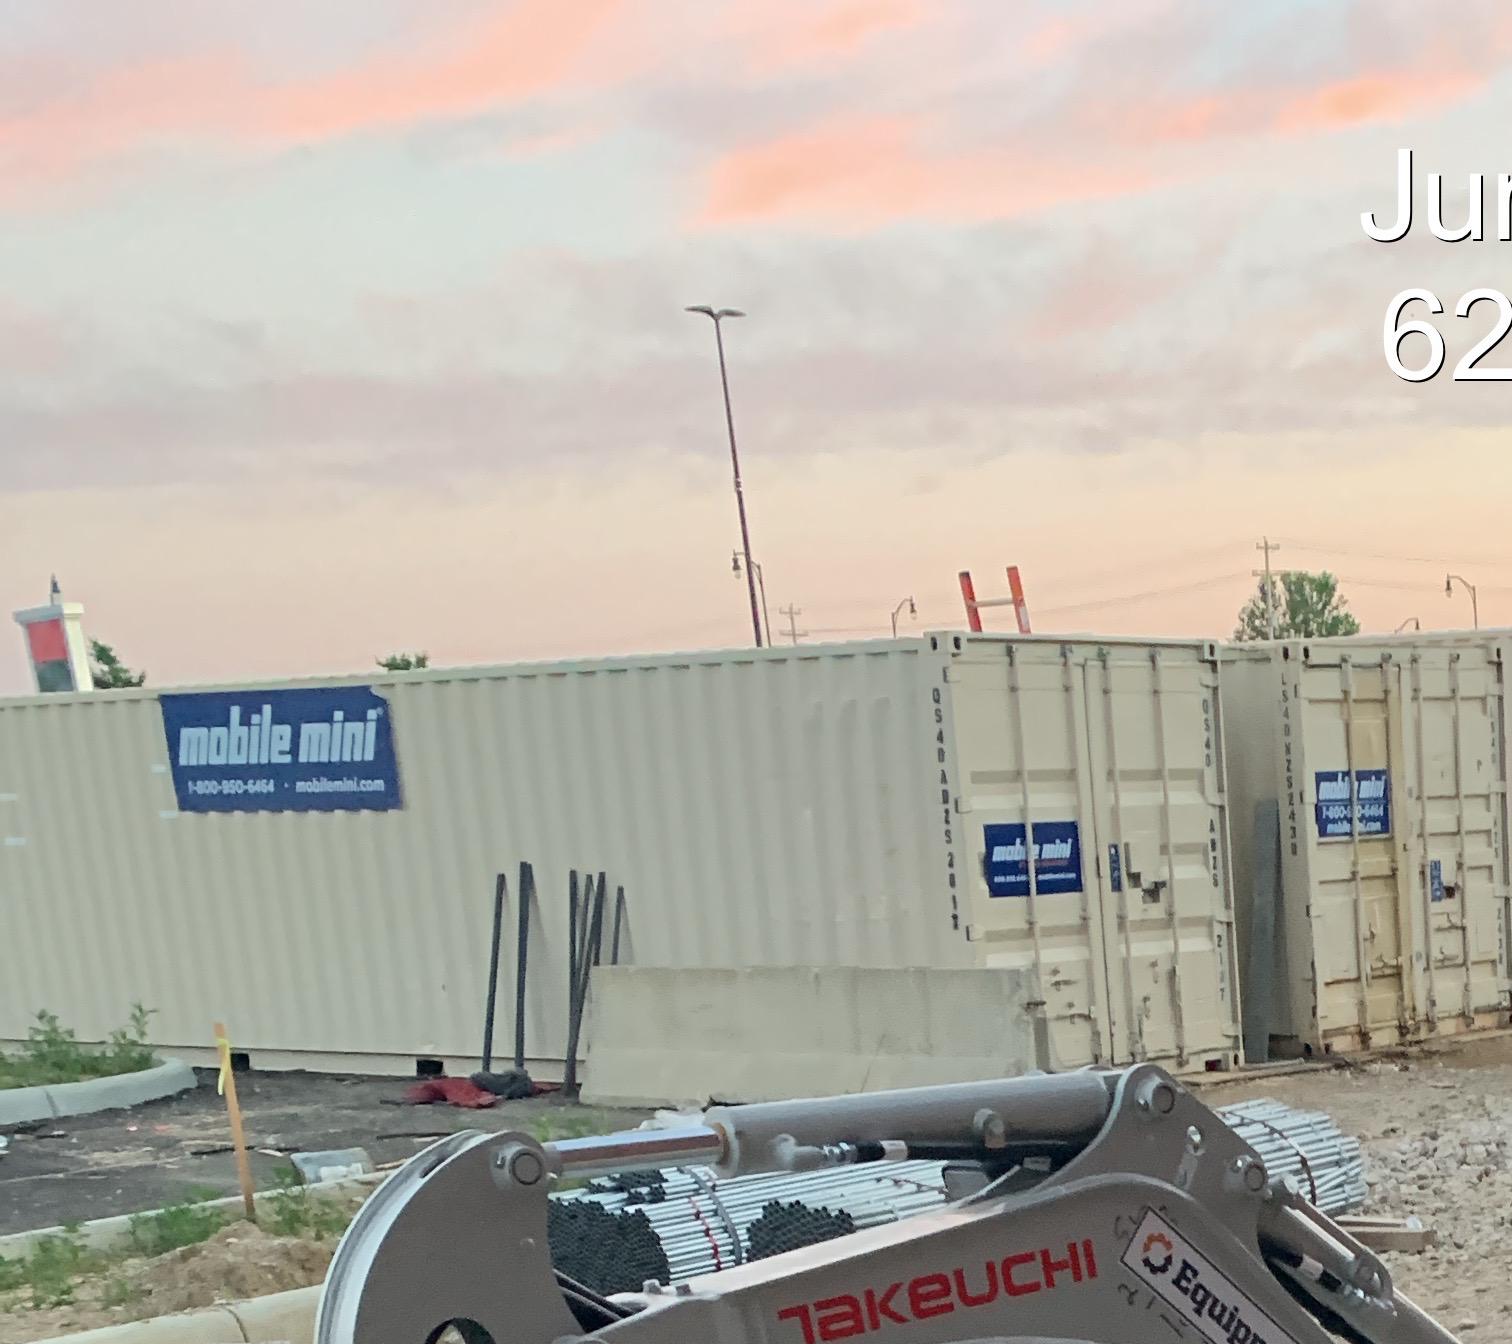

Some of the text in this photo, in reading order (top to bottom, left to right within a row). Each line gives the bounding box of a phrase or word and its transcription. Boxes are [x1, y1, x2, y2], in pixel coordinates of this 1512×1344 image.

[178, 704, 378, 766] mobile mini
[295, 777, 385, 793] mobilemini.com
[1319, 772, 1358, 800] mobi
[992, 837, 1041, 862] mobe
